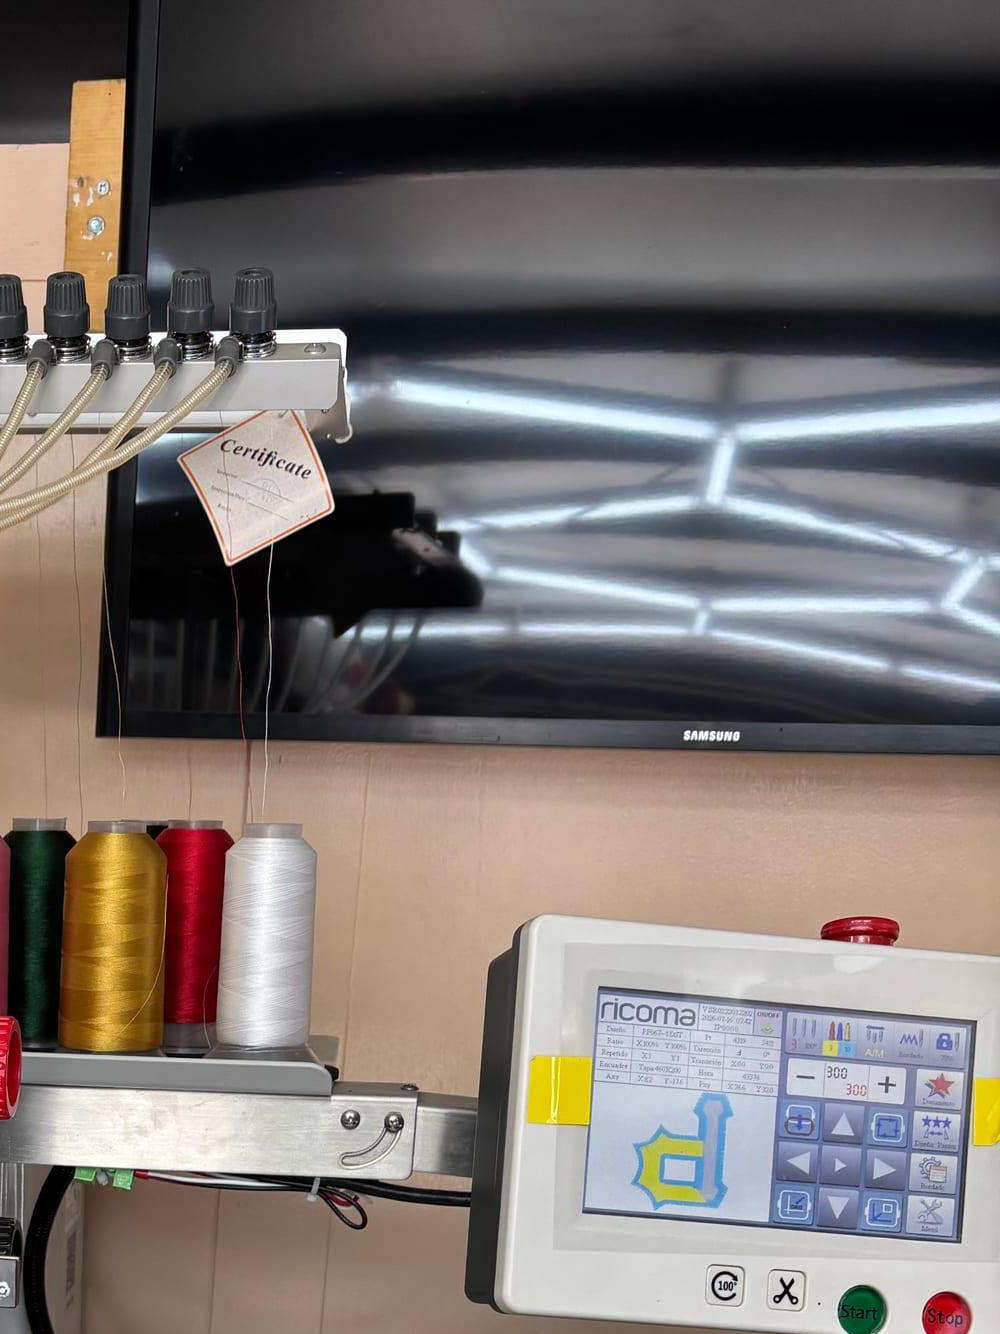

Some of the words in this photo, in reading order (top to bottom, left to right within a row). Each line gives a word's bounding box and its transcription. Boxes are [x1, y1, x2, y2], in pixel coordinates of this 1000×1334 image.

[220, 438, 312, 480] Certificate
[683, 730, 741, 742] SAMSUNG
[600, 998, 696, 1027] ricoma
[827, 1066, 848, 1080] 300
[846, 1083, 867, 1097] 300
[841, 1304, 879, 1321] Start
[927, 1308, 964, 1327] Stop
